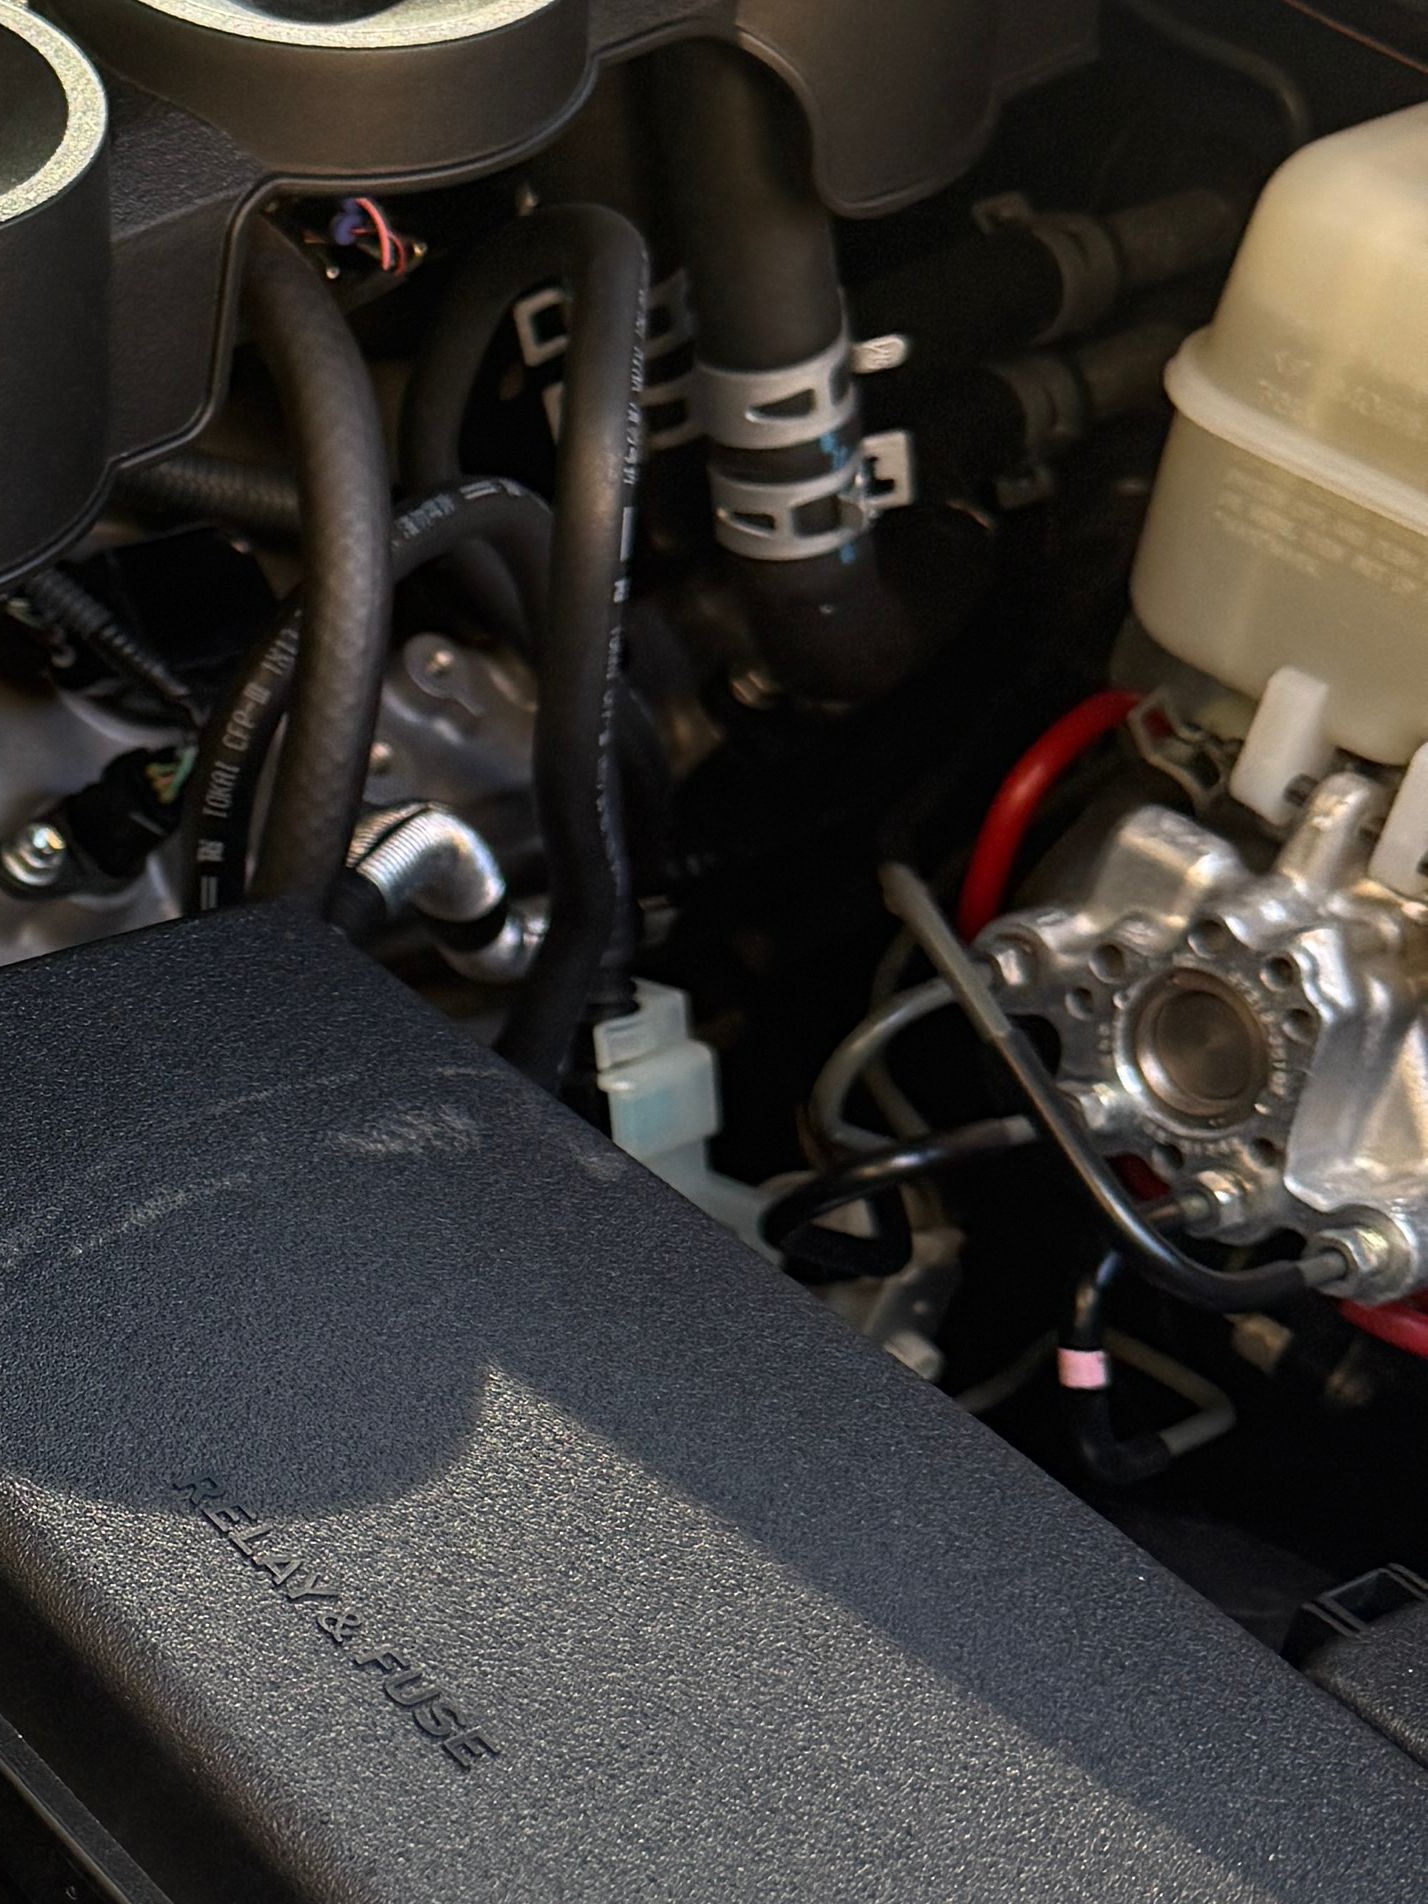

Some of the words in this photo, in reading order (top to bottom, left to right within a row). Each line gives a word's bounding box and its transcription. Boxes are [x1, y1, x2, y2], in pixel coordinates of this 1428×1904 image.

[171, 1471, 342, 1605] RELAY
[316, 1606, 366, 1646] &
[351, 1644, 502, 1774] FUSE
